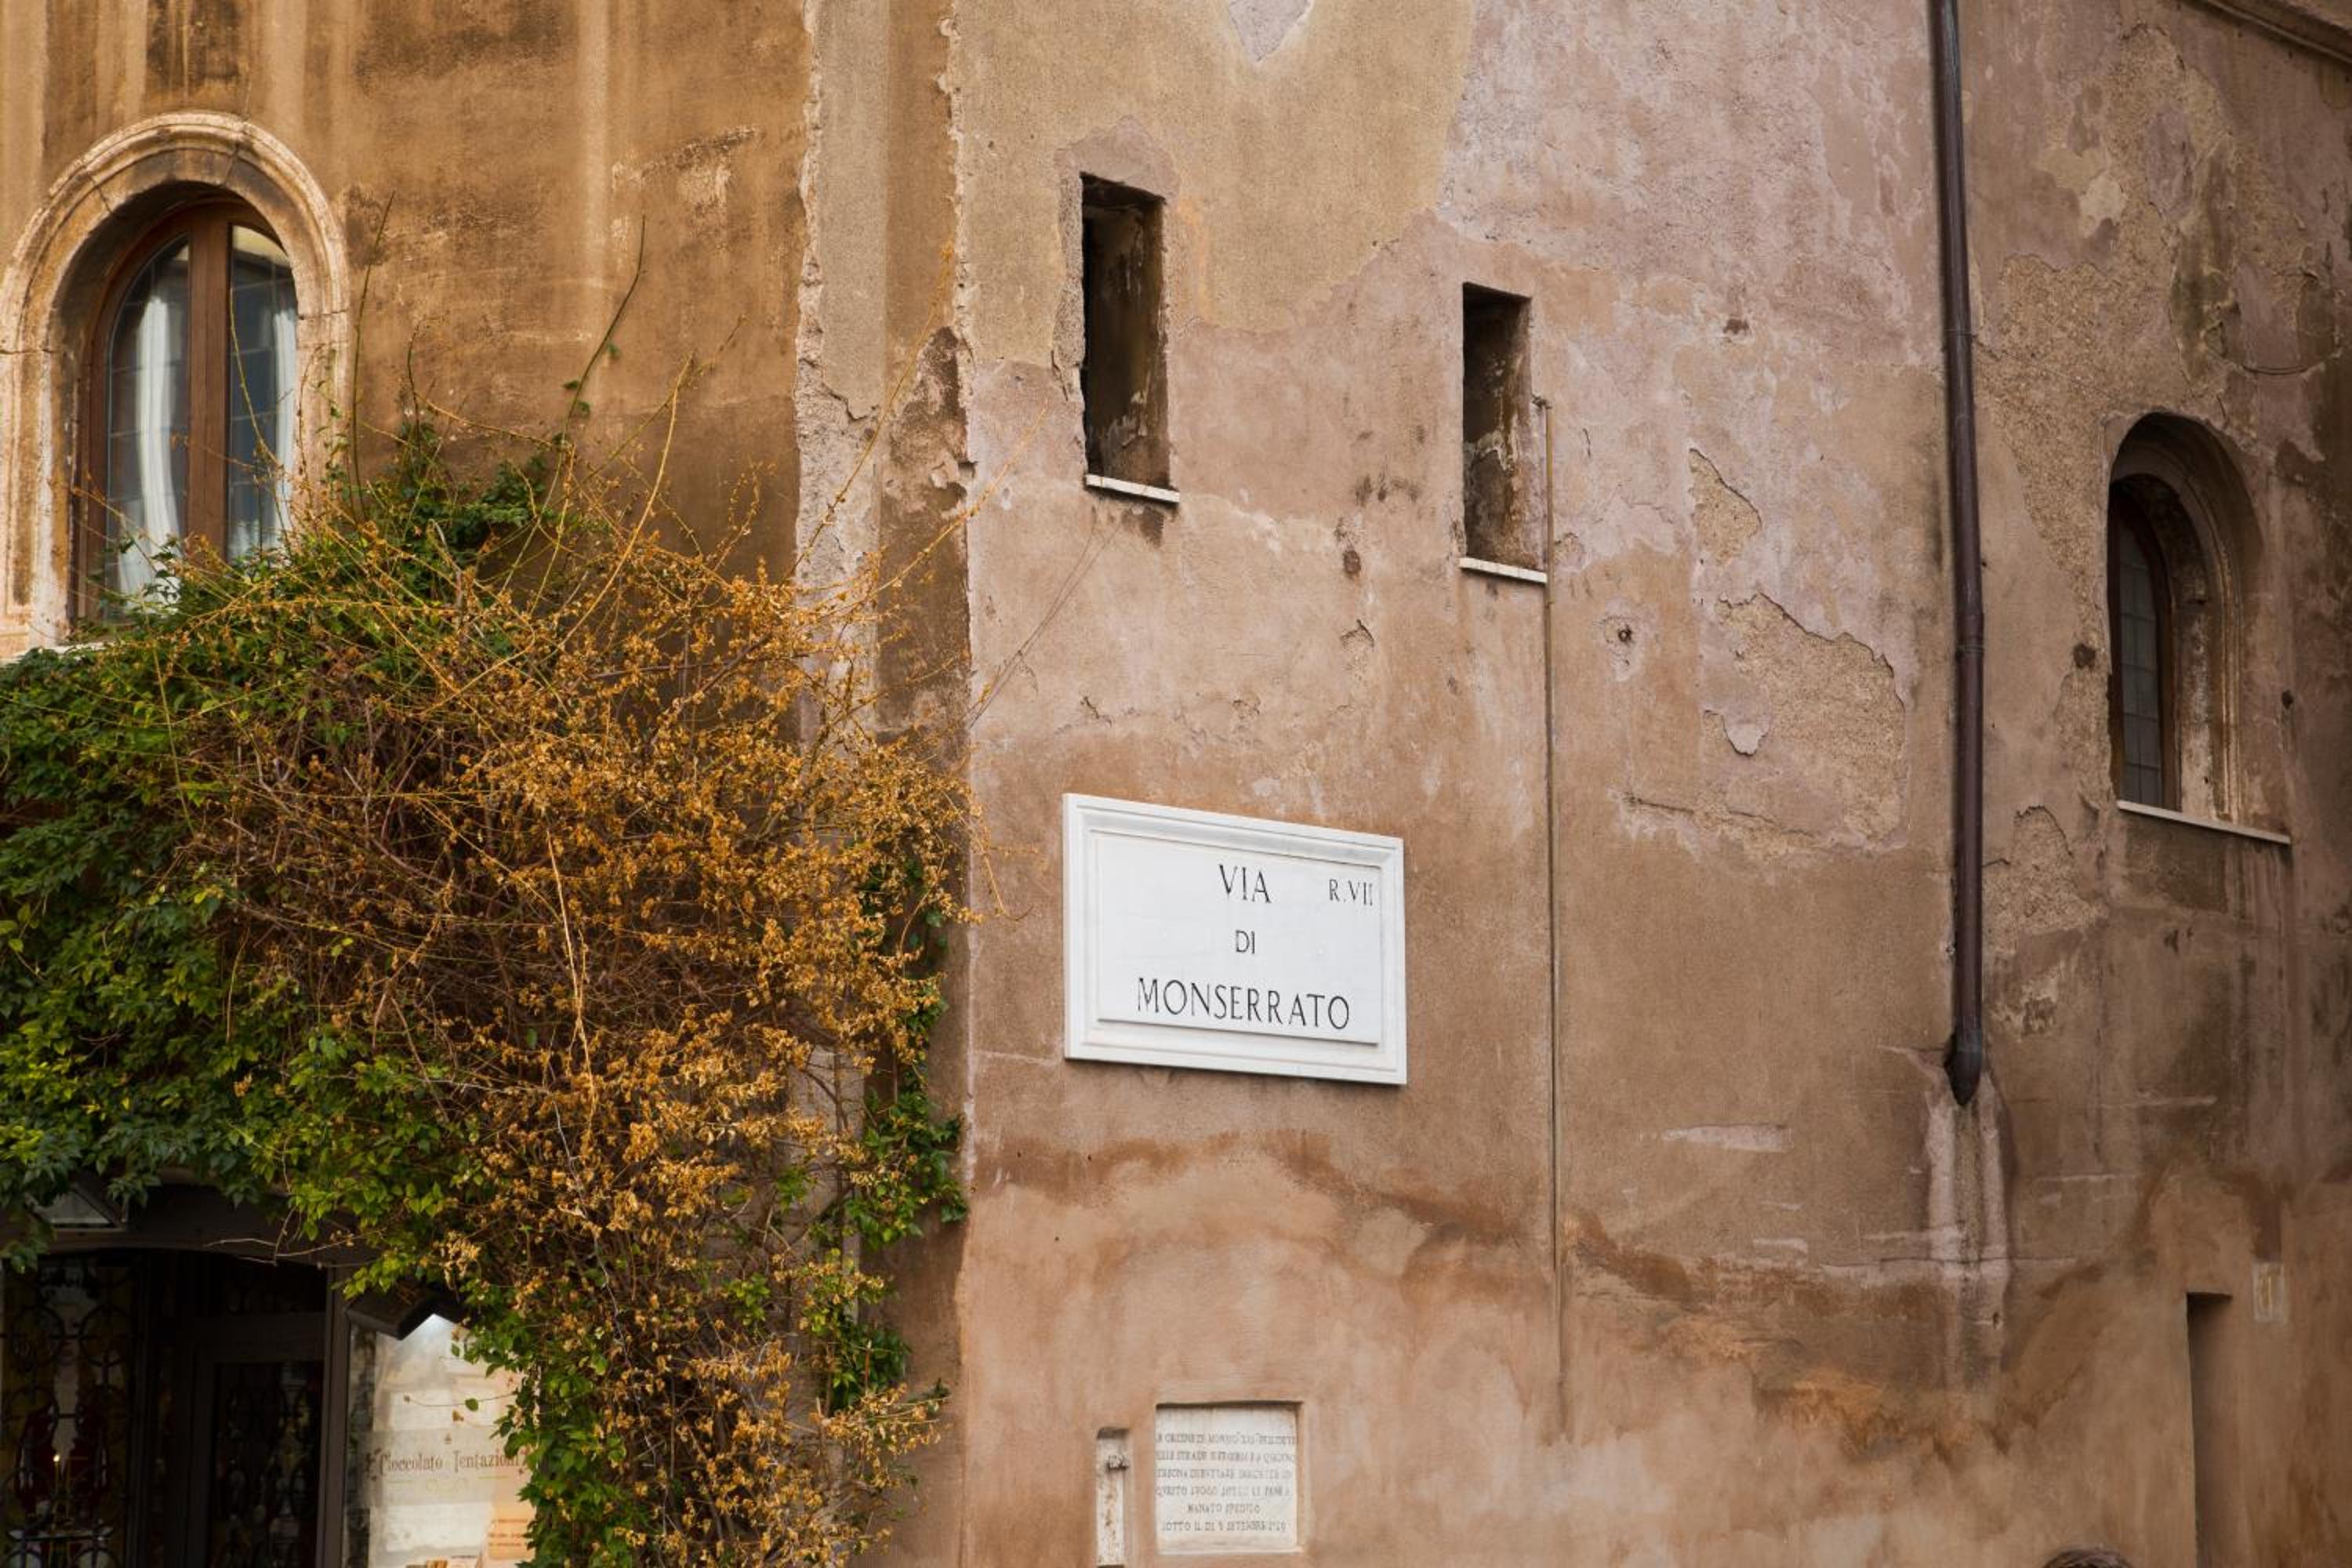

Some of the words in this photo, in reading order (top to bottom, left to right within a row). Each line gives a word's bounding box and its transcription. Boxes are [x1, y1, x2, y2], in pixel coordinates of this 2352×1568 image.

[1218, 864, 1272, 903] VIA
[1235, 930, 1255, 954] DI
[1137, 977, 1350, 1030] MONSERRATO
[379, 1450, 444, 1475] Cioccolato
